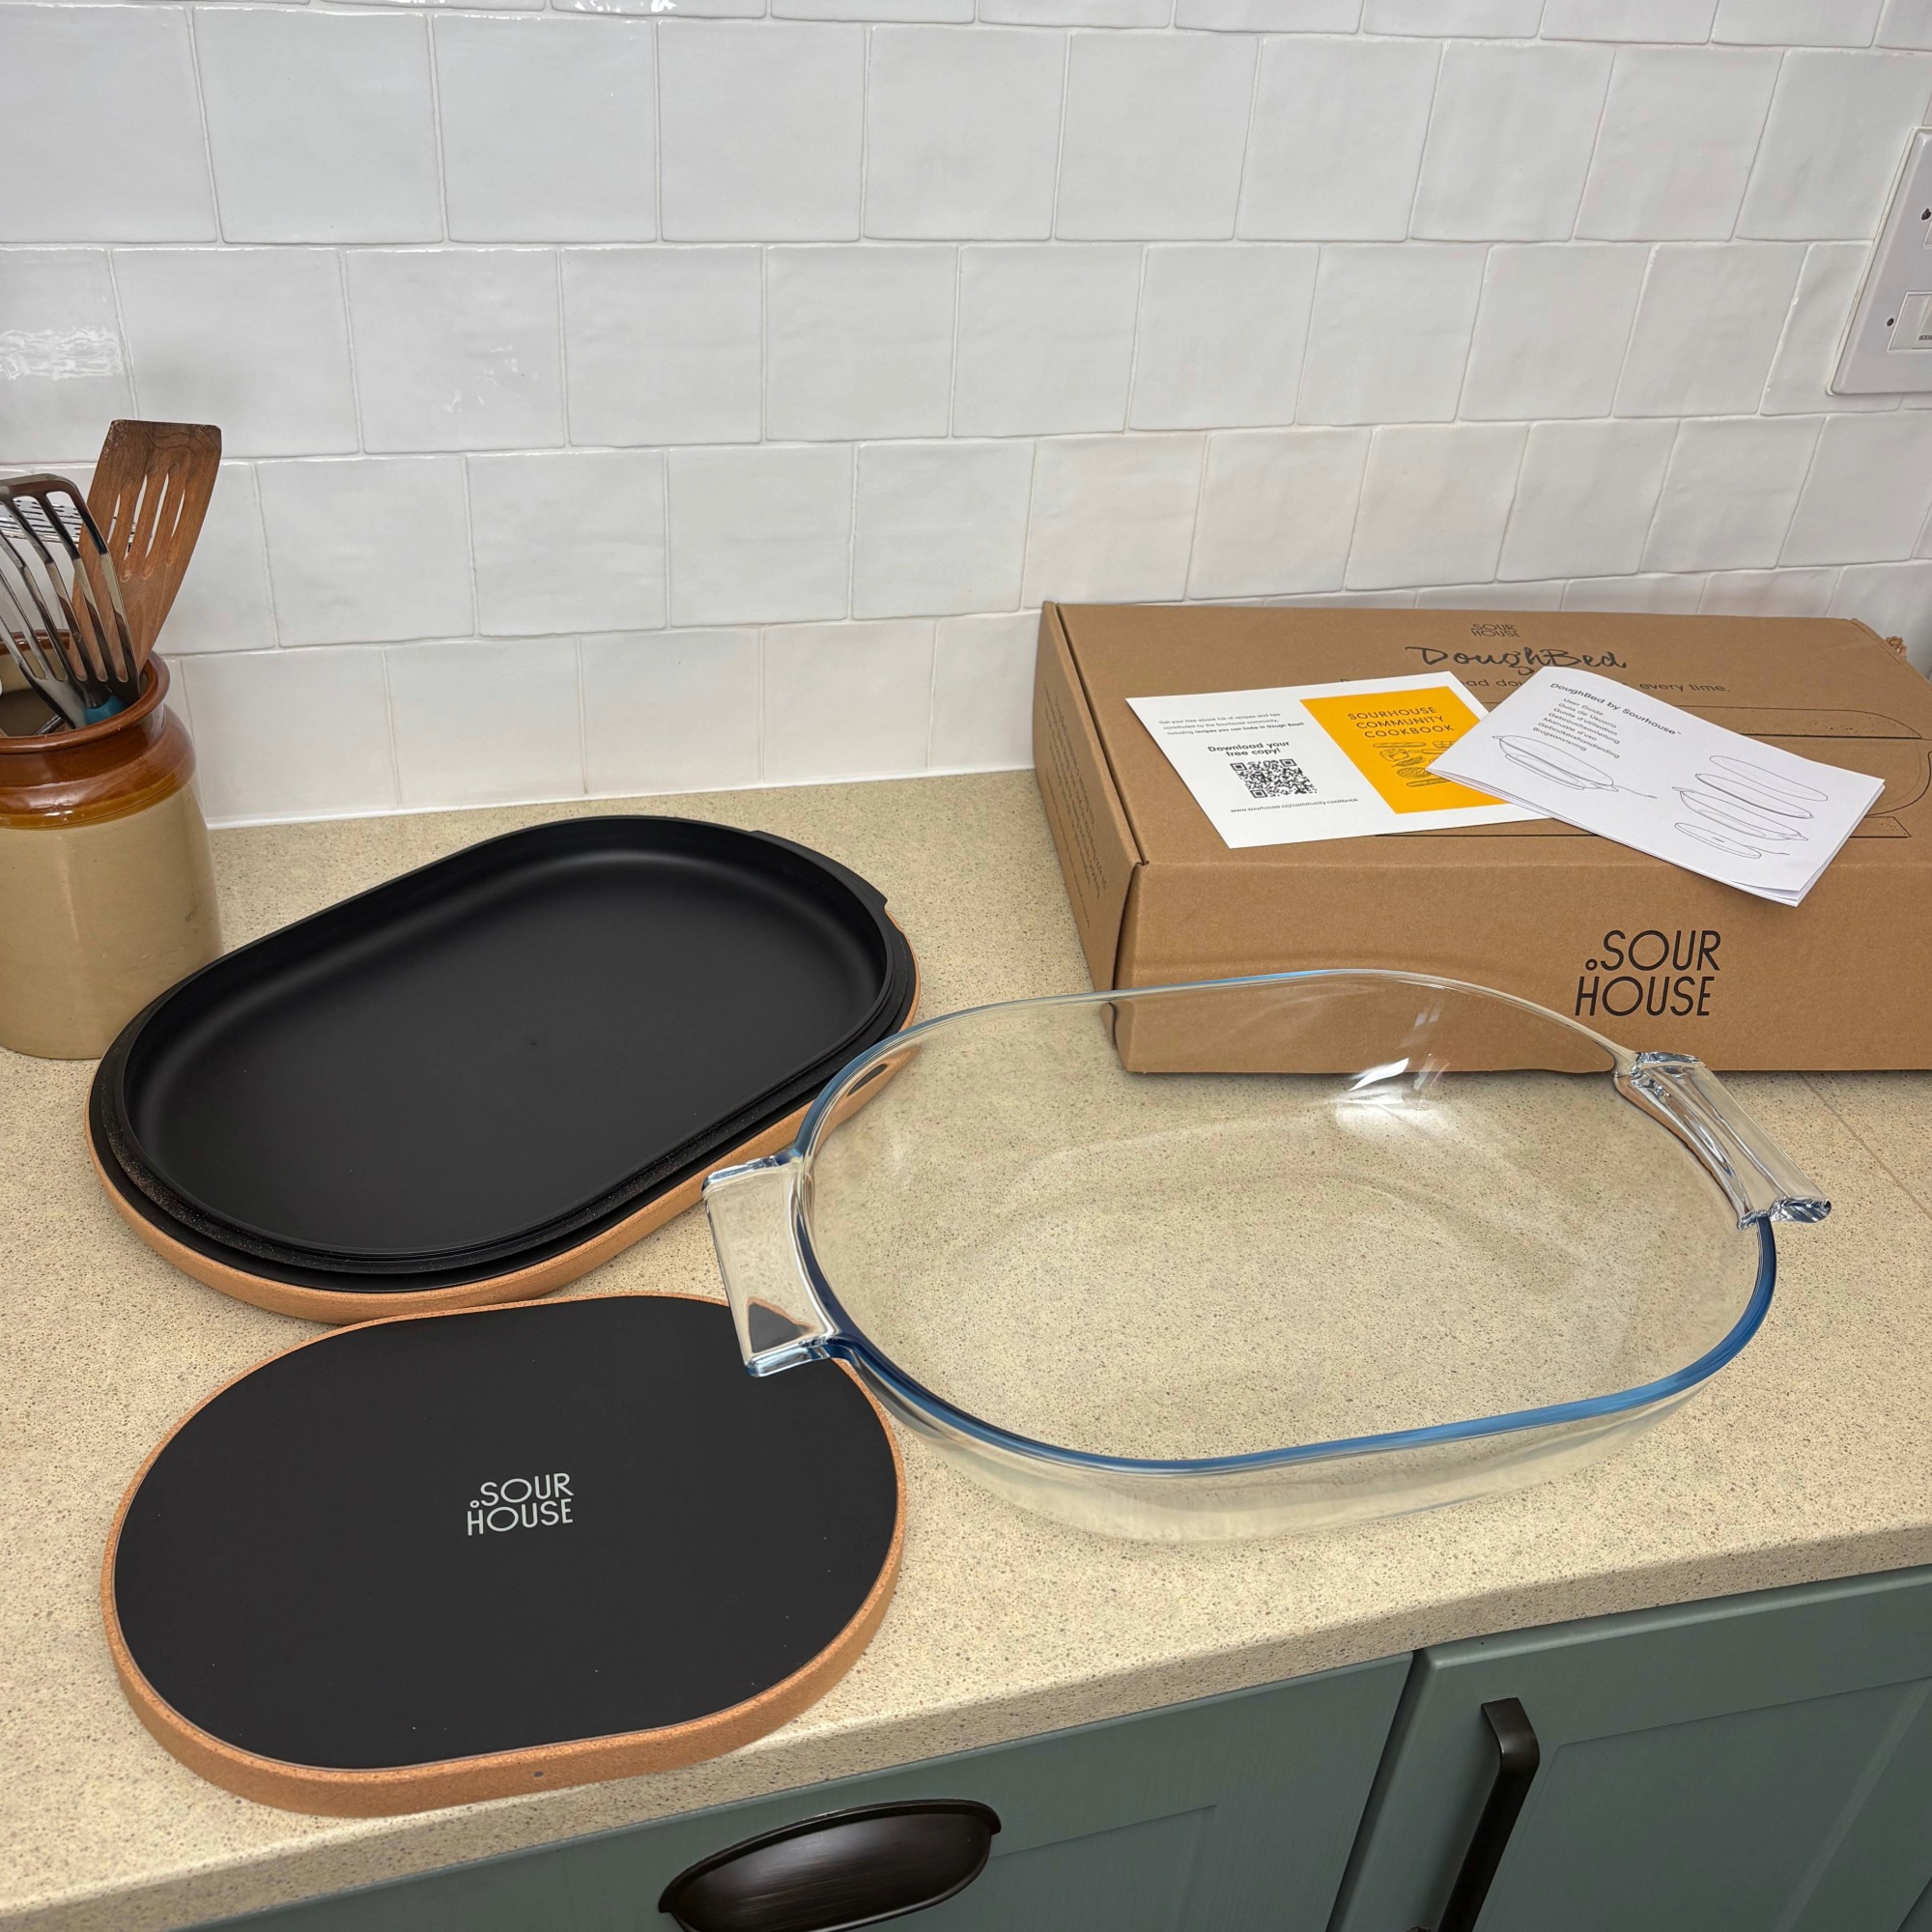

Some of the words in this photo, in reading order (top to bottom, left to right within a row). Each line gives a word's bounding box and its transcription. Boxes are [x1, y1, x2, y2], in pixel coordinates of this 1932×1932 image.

[1471, 629, 1521, 638] HOUSE
[1406, 646, 1627, 675] DoughBed
[1639, 683, 1684, 692] every
[1689, 683, 1731, 692] time.
[1549, 682, 1605, 704] DoughBed
[1606, 700, 1621, 711] by
[1348, 706, 1437, 720] SOURHOUSE
[1553, 707, 1576, 718] Guide
[1563, 697, 1580, 707] User
[1581, 704, 1604, 716] Guide
[1356, 715, 1444, 729] COMMUNITY
[1543, 717, 1576, 732] Manuale
[1589, 713, 1617, 728] Usuario
[1364, 724, 1455, 738] COOKBOOK
[1532, 727, 1587, 752] Brugsanvisning
[1207, 742, 1264, 753] Download
[1251, 748, 1281, 756] copy!
[1600, 929, 1721, 971] SOUR
[1575, 976, 1716, 1017] HOUSE
[480, 1472, 575, 1507] SOUR
[467, 1498, 574, 1536] HOUSE
